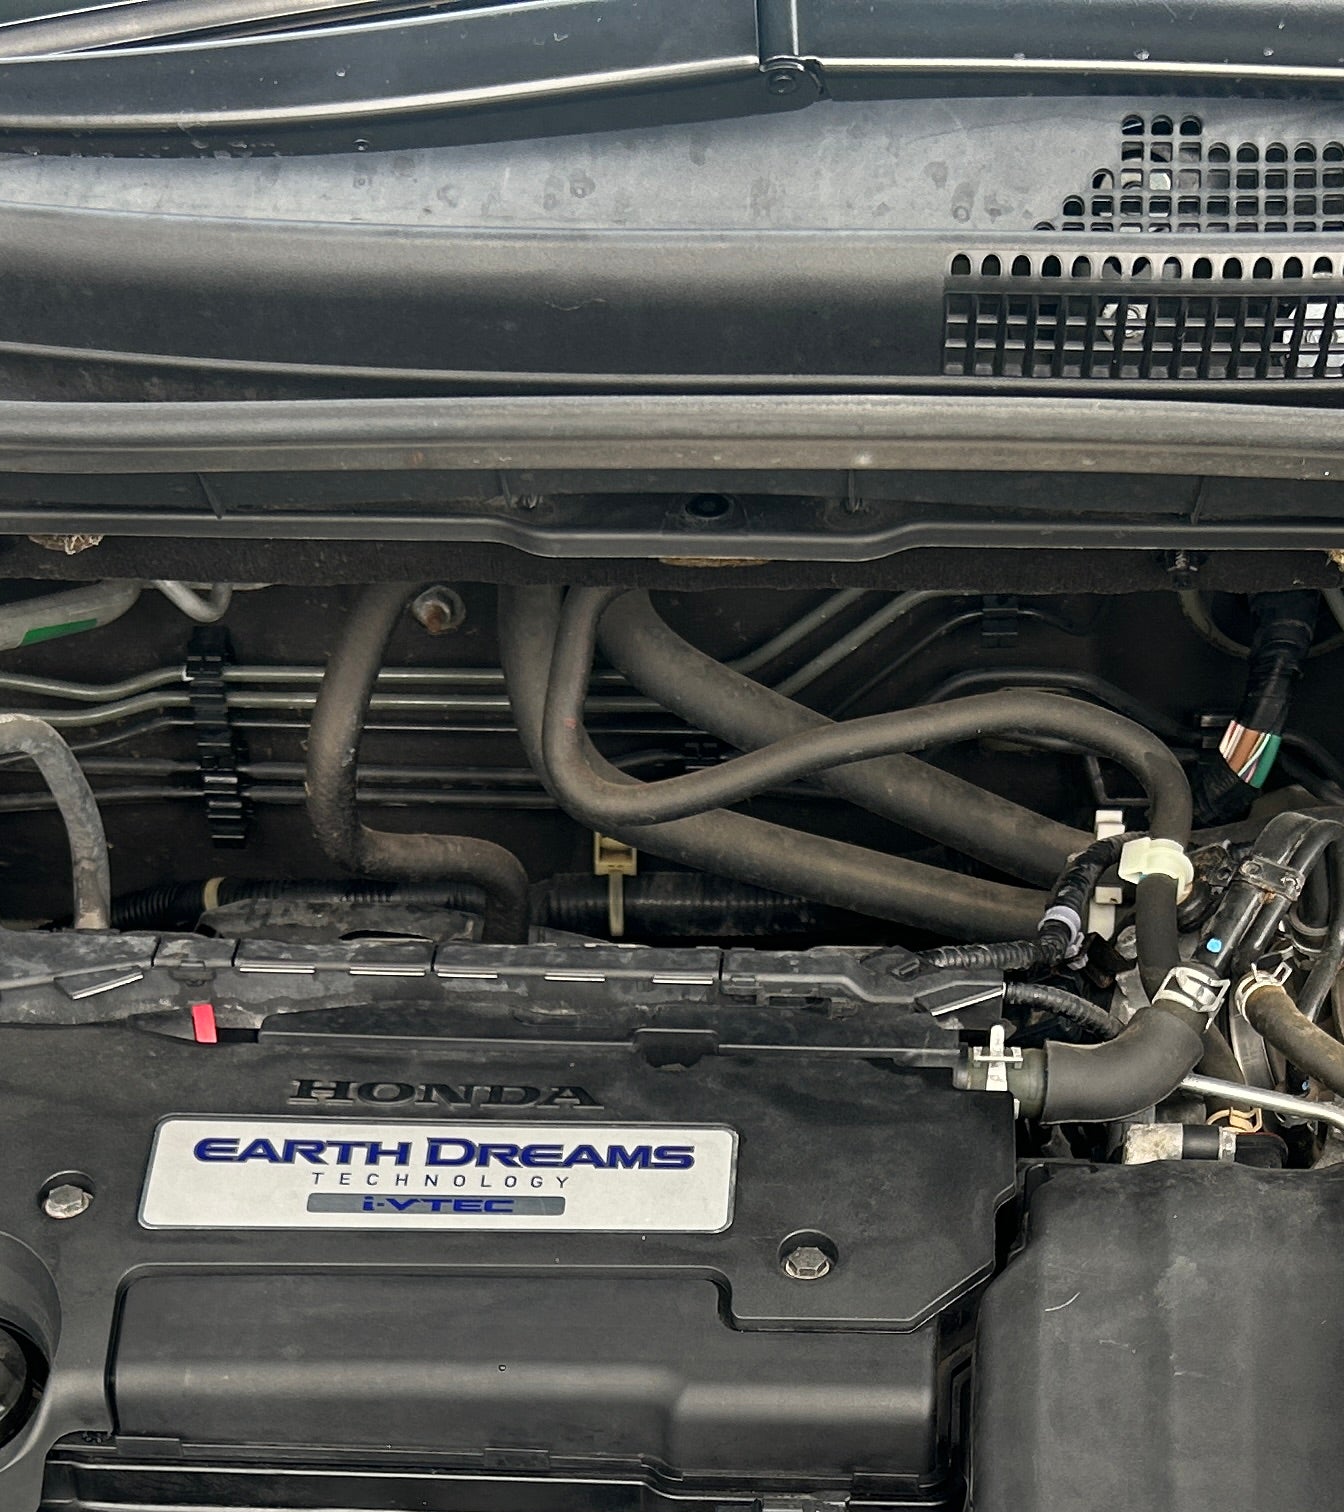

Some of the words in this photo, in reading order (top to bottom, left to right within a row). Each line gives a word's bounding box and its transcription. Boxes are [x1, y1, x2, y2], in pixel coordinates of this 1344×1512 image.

[288, 1079, 605, 1110] HONDA
[193, 1136, 413, 1167] EARTH
[424, 1136, 695, 1170] DREAMS
[310, 1171, 572, 1189] TECHNOLOGY
[362, 1195, 515, 1214] i-VTEC
